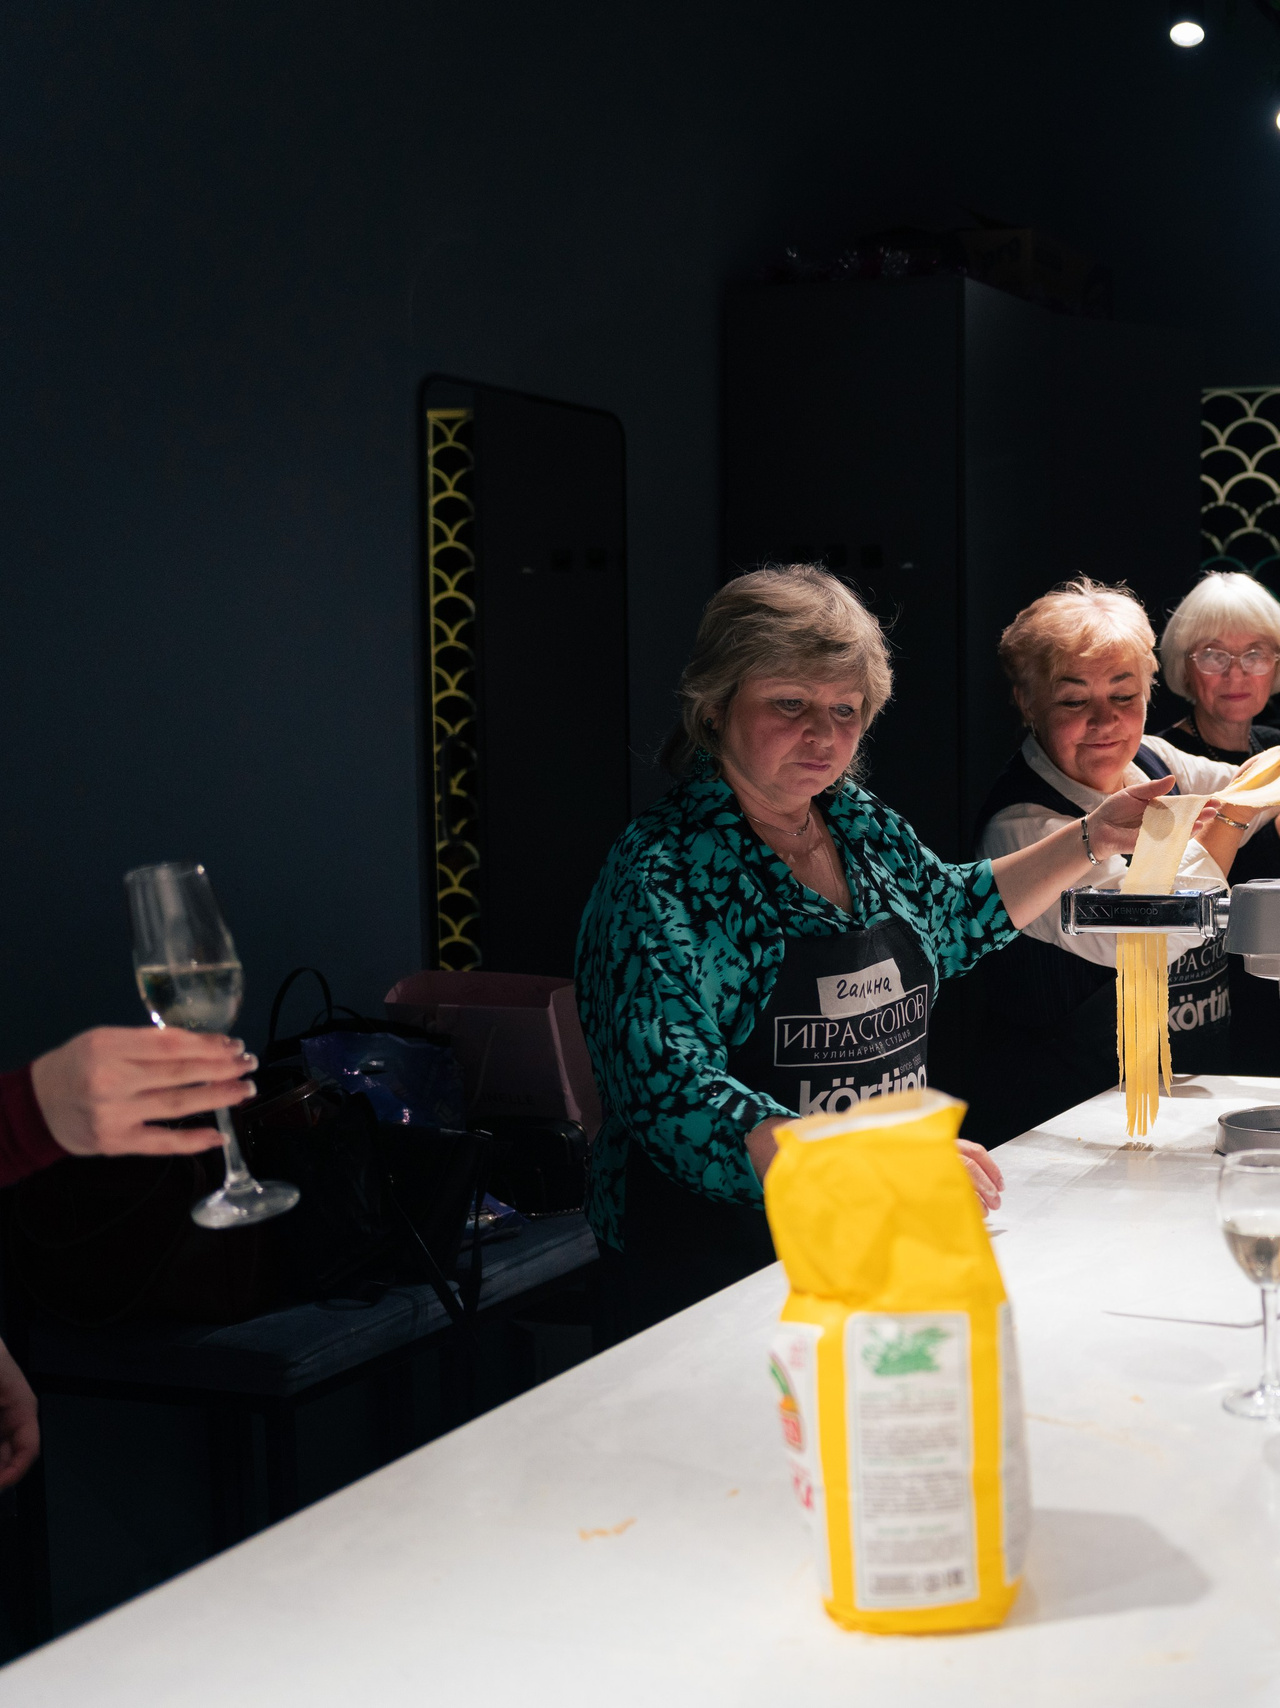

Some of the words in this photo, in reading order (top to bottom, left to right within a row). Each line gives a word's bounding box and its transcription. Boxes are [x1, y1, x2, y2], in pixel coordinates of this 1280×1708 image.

[1114, 906, 1159, 916] KENWOOD
[783, 1020, 859, 1049] ИГРА
[858, 992, 925, 1042] СТОЛОВ
[813, 1041, 885, 1060] КУЛИНАРНАЯ
[885, 1028, 912, 1046] СТУДИЯ
